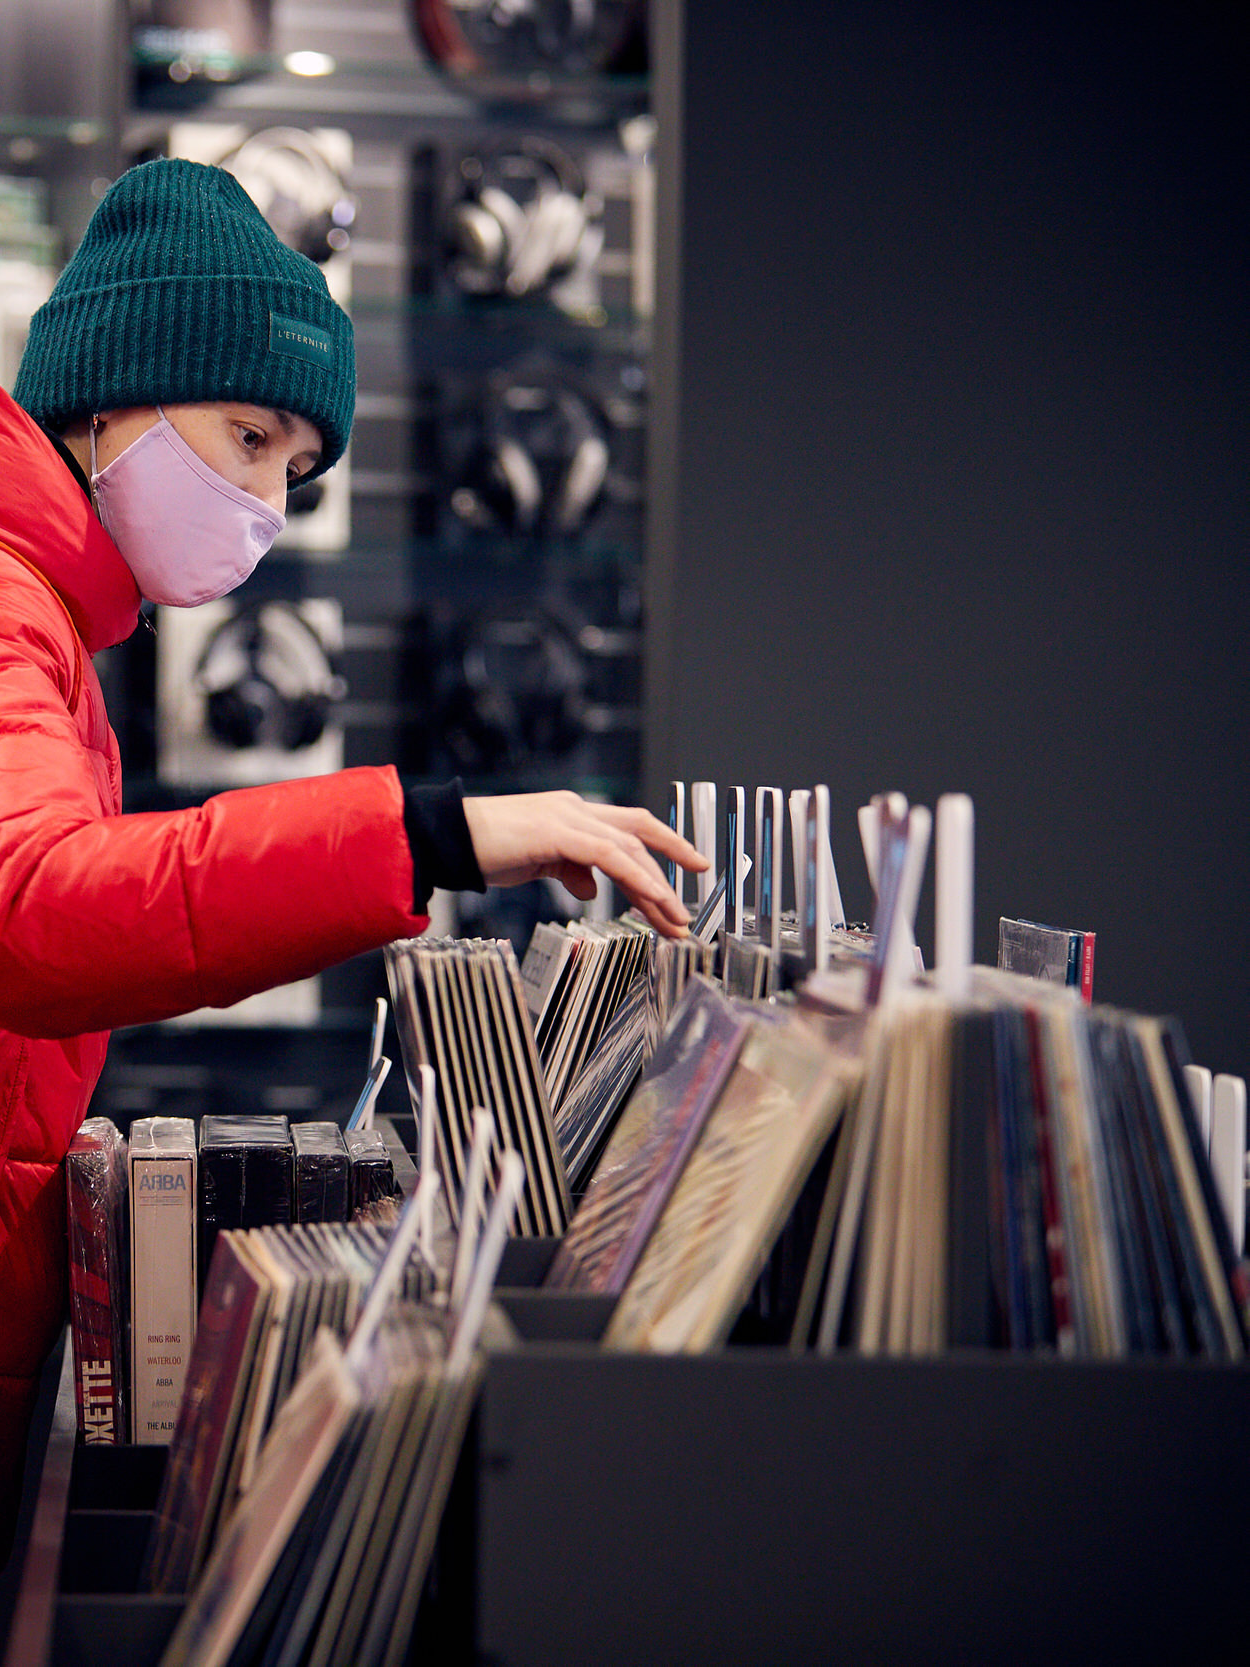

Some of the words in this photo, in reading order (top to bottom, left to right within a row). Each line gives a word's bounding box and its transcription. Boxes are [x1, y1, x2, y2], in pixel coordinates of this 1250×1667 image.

[139, 1174, 186, 1190] ABBA
[147, 1335, 163, 1343] RING
[165, 1335, 181, 1343] RING
[147, 1356, 181, 1365] WATERLOO
[156, 1378, 173, 1387] ABBA
[82, 1360, 114, 1445] XETTE
[147, 1422, 159, 1430] THE
